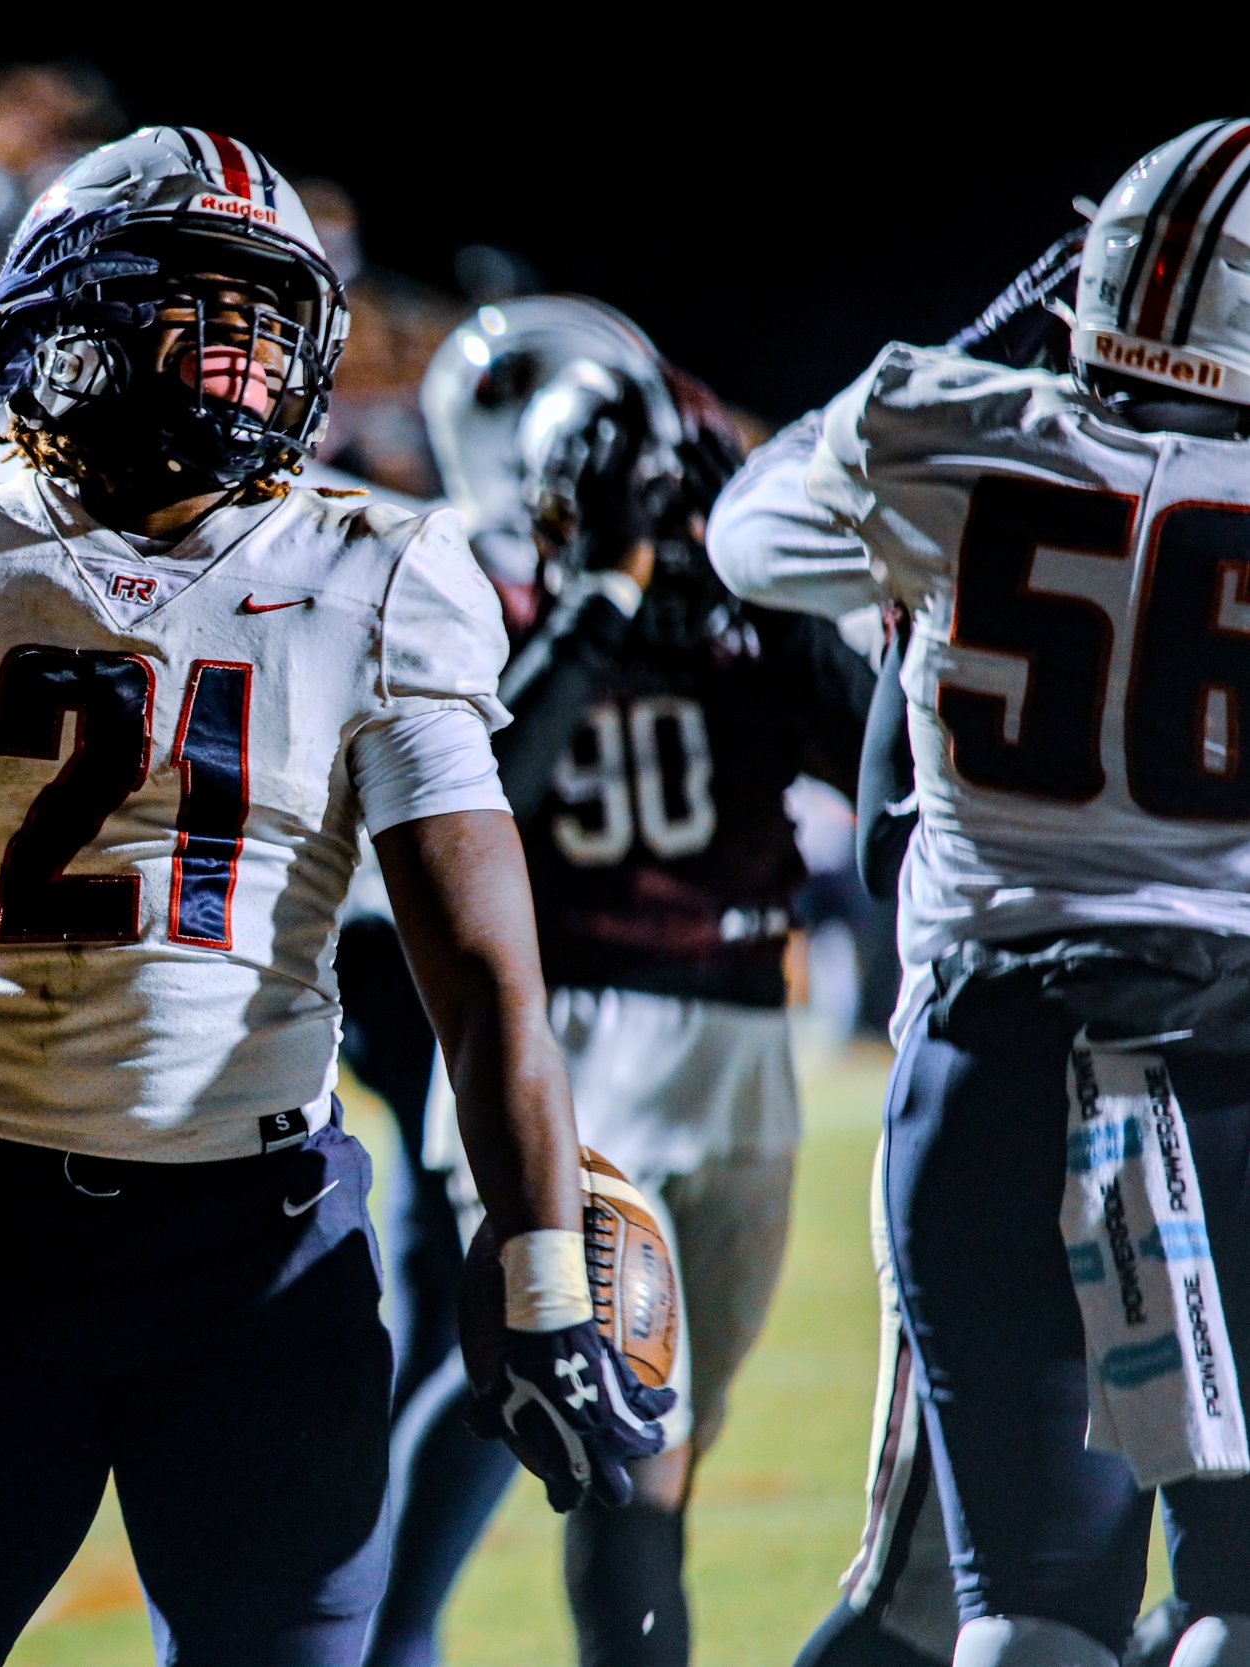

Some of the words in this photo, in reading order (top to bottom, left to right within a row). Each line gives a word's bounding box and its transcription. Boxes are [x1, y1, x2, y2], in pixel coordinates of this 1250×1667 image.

[201, 196, 277, 224] Riddell
[1096, 335, 1222, 388] Riddell
[937, 475, 1250, 820] 56
[553, 697, 717, 866] 90
[275, 1113, 290, 1131] S
[1183, 1272, 1221, 1418] POWERADE
